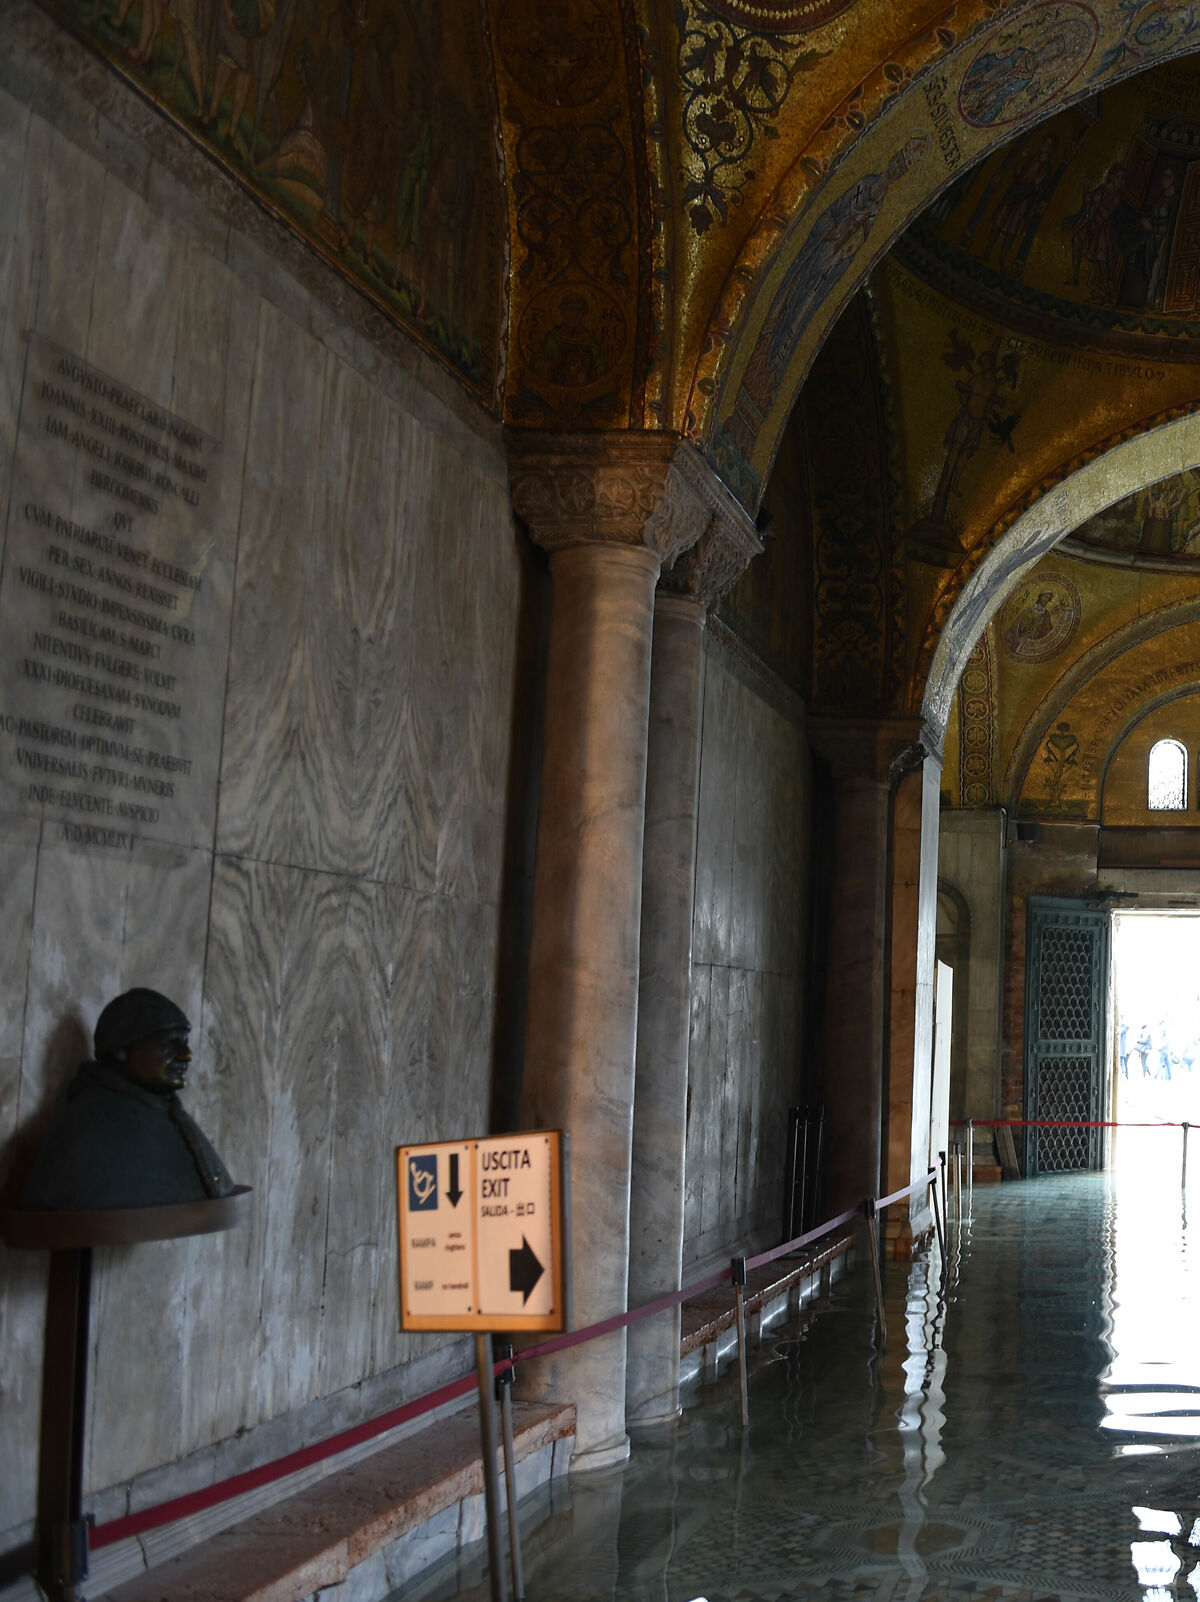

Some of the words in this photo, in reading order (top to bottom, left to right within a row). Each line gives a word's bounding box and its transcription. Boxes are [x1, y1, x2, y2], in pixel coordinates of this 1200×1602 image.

[40, 380, 86, 420] IOANNIS
[90, 407, 115, 435] XXIII
[45, 413, 68, 441] IAM
[47, 543, 70, 569] PER
[71, 553, 94, 578] SEX
[97, 563, 132, 593] ANNOS
[482, 1149, 531, 1171] USCITA
[482, 1178, 510, 1198] EXIT
[481, 1204, 508, 1217] SALIDA
